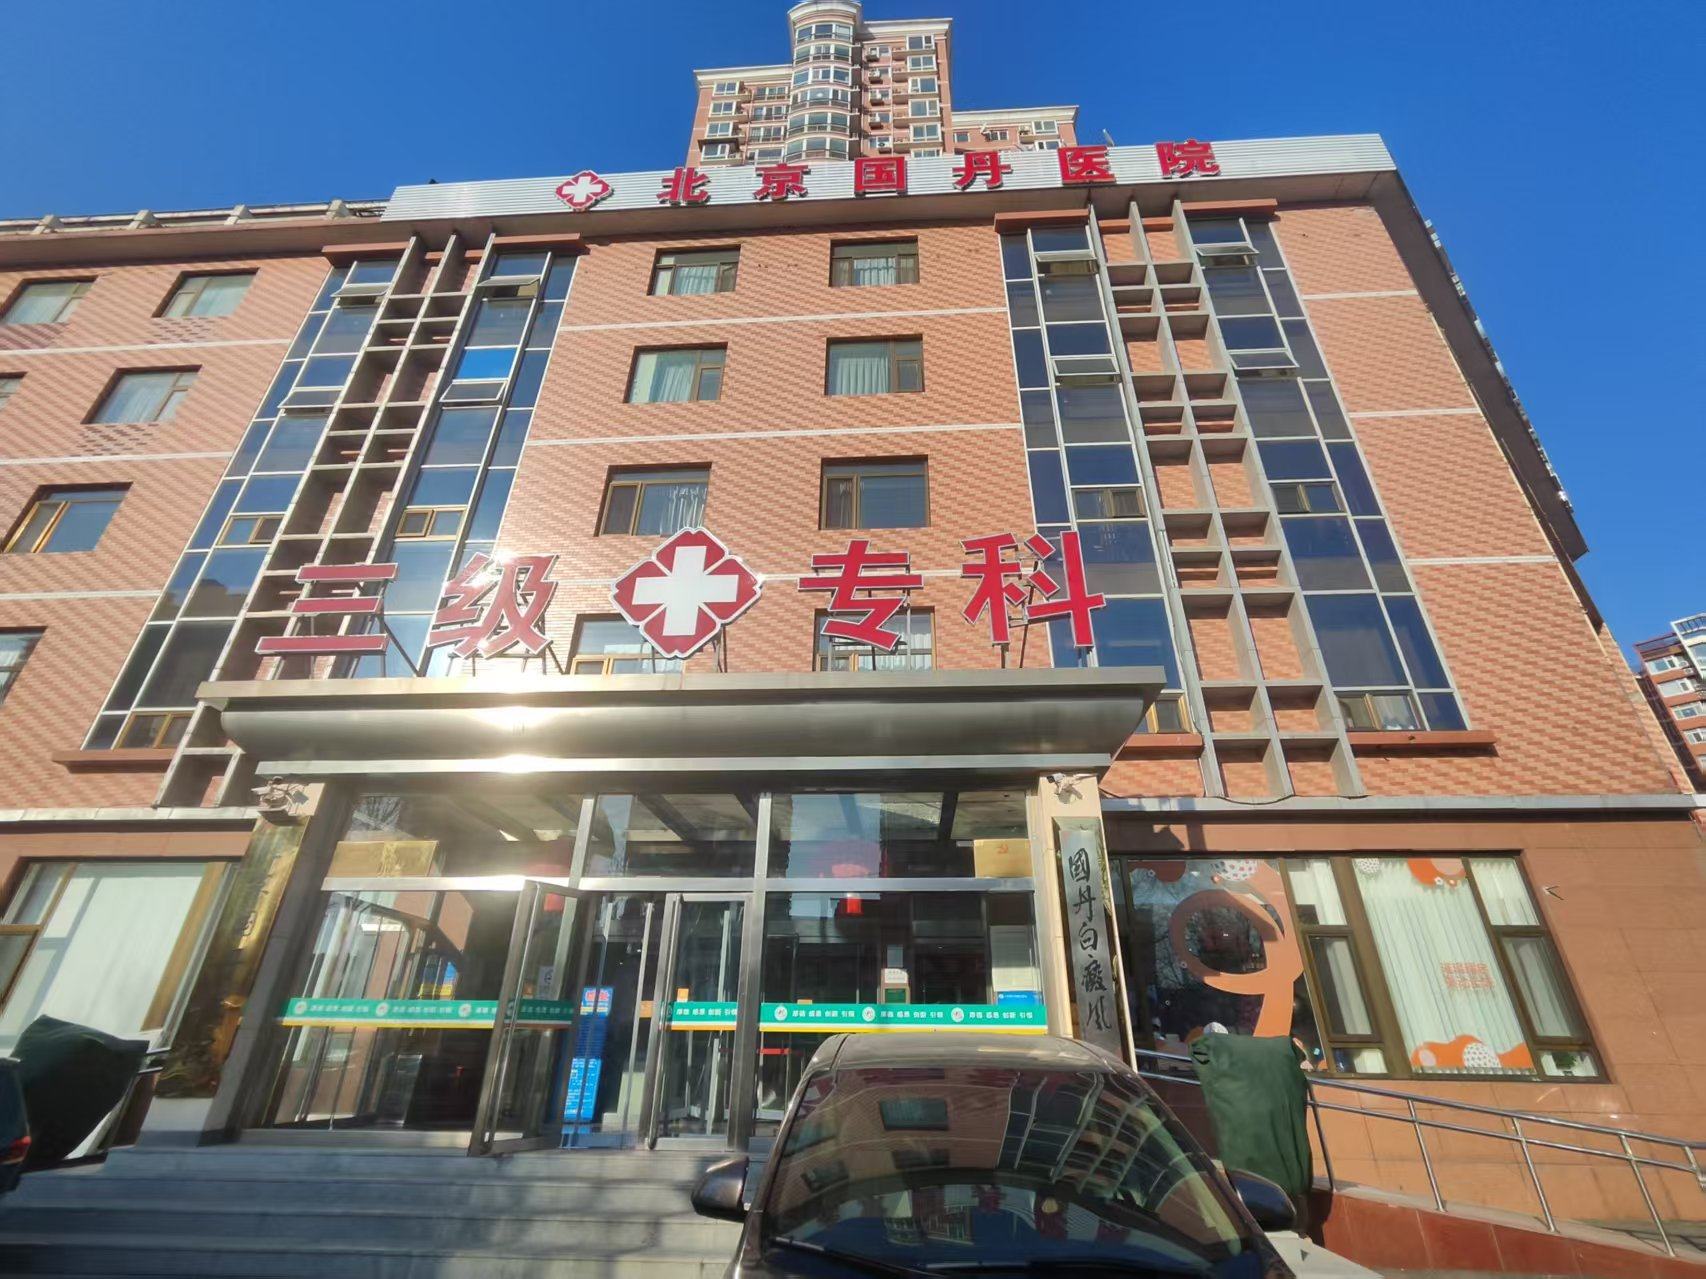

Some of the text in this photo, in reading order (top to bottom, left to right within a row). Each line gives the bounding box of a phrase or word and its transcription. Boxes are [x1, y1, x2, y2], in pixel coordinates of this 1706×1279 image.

[657, 139, 1221, 204] 北京国丹医院
[254, 530, 1106, 659] 三级 专科
